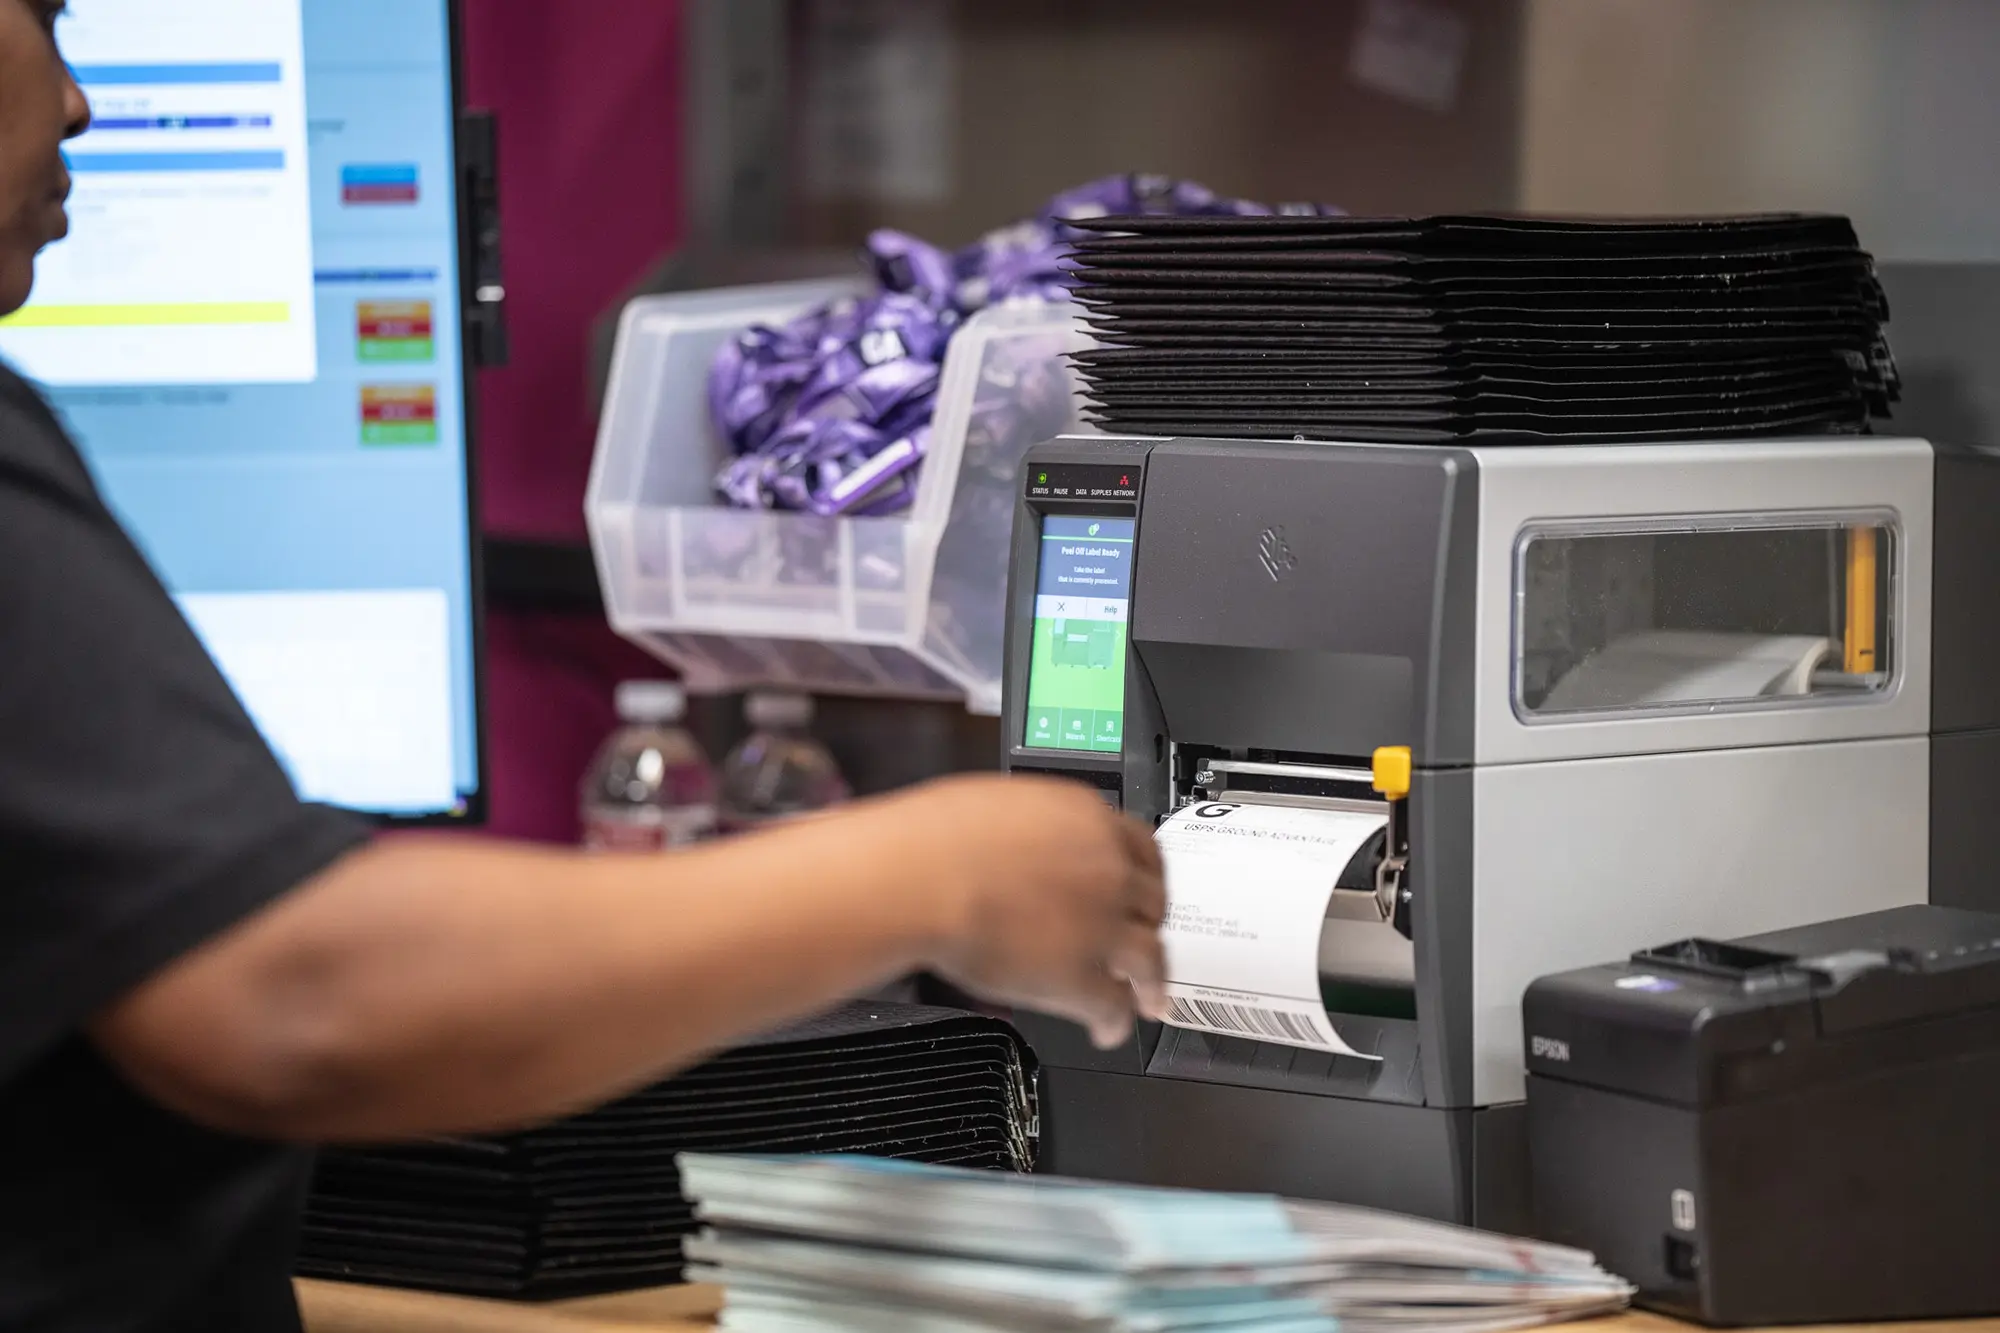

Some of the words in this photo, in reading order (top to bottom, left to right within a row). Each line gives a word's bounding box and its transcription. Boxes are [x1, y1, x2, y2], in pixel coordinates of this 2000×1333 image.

[1032, 487, 1049, 495] STATUS
[1053, 487, 1068, 495] PAUSE
[1112, 489, 1135, 497] NETWORK
[1085, 547, 1101, 557] Label
[1102, 548, 1120, 559] Ready
[1104, 605, 1118, 614] Help
[1195, 803, 1241, 819] G
[1184, 822, 1216, 833] USPS
[1217, 827, 1267, 838] GROUND
[1269, 831, 1338, 846] ADVANTAGE
[1531, 1036, 1570, 1062] EPSON
